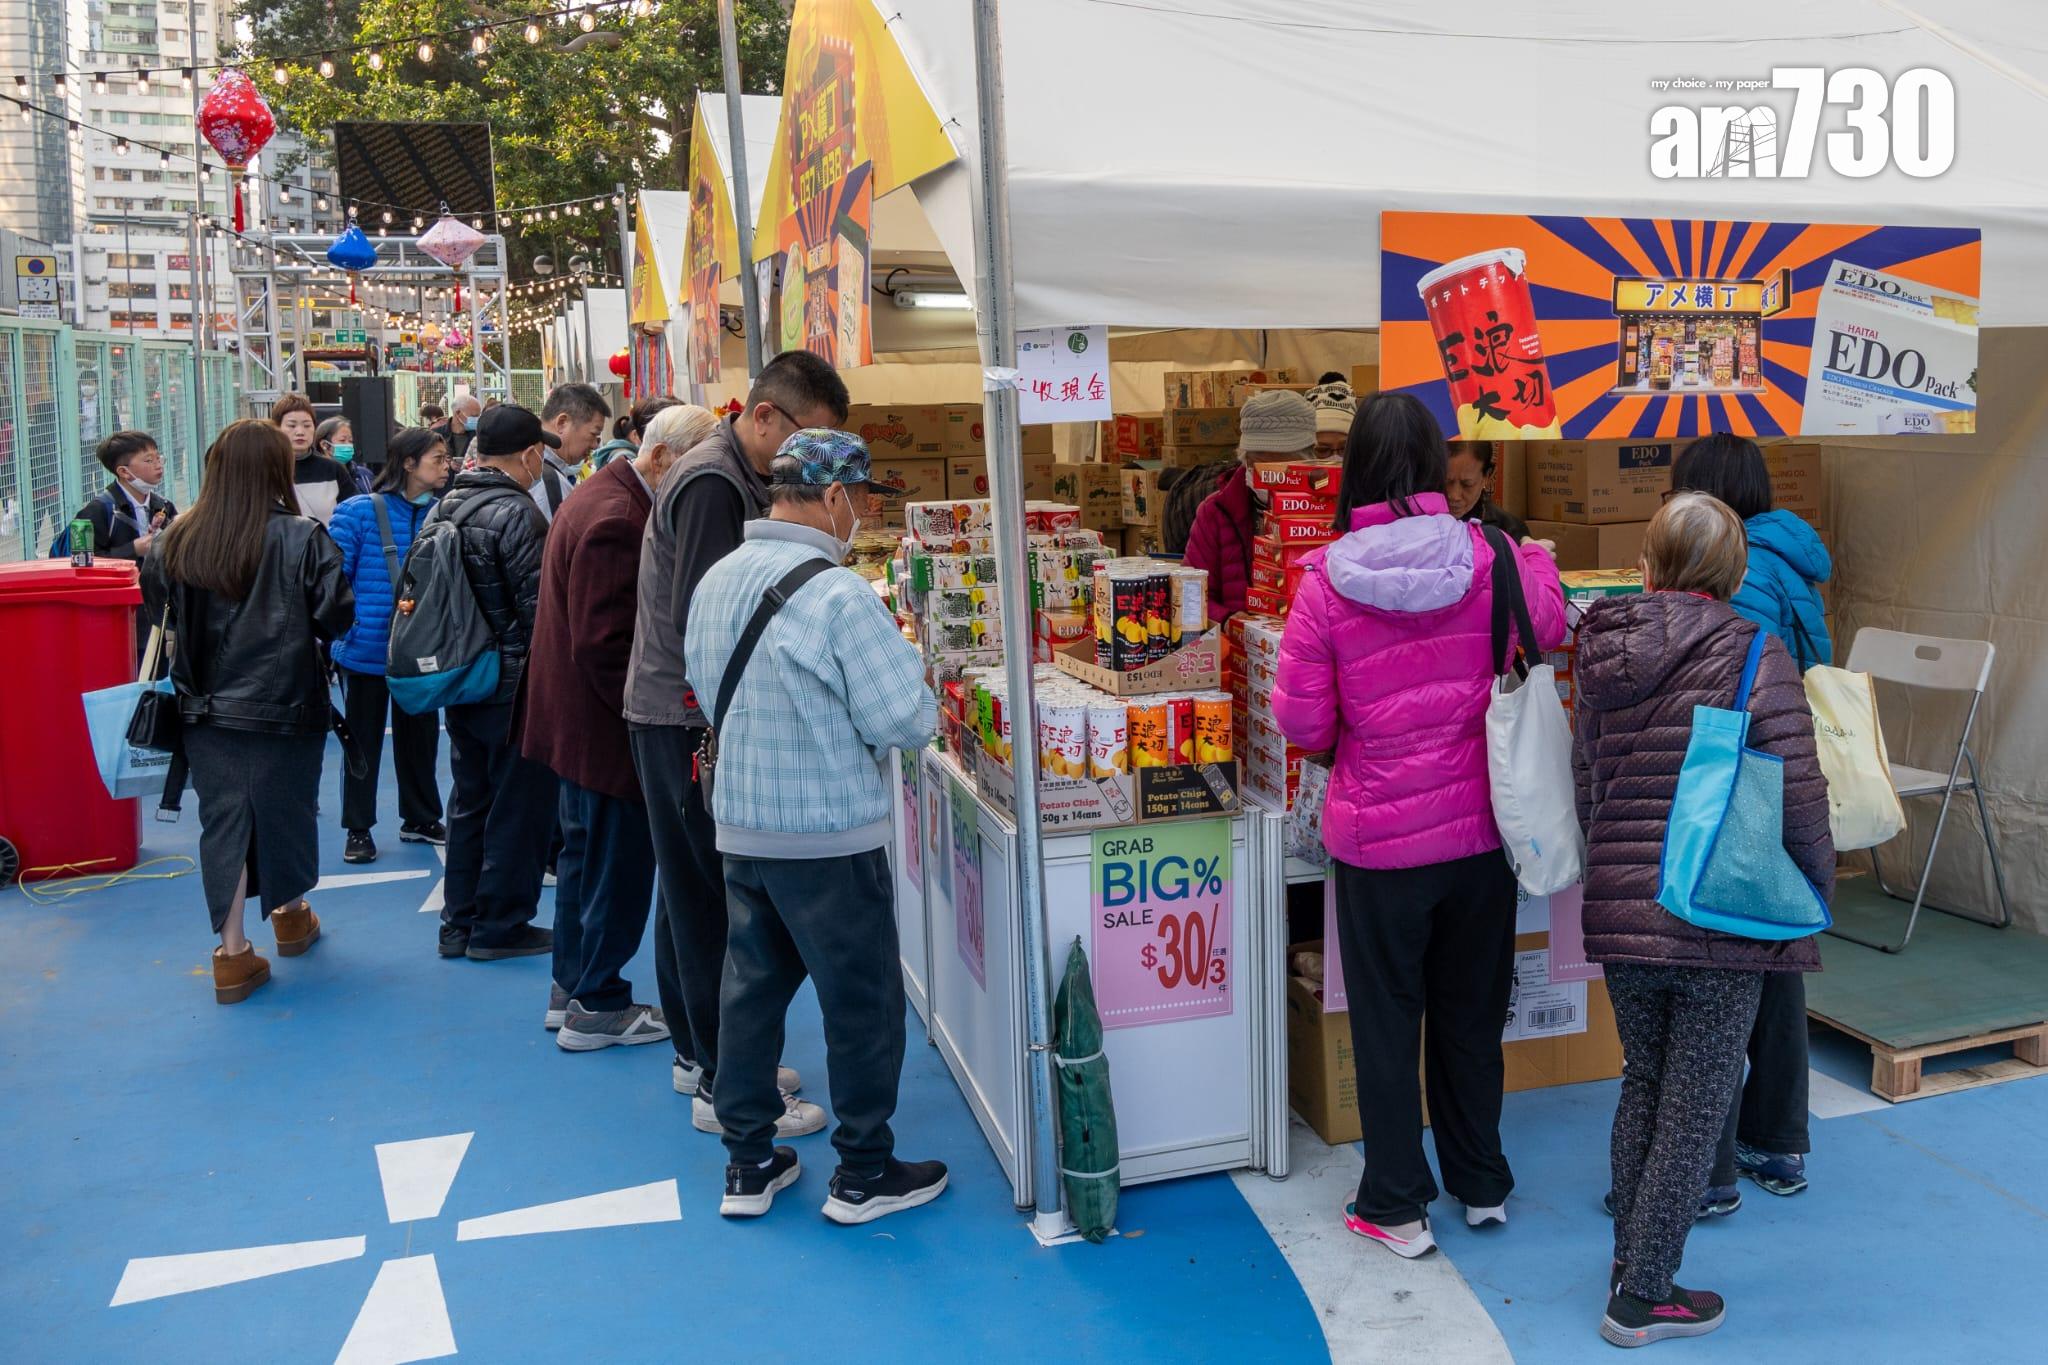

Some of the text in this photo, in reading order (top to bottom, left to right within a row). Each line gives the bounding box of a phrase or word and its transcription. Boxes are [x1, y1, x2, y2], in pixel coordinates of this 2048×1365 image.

[42, 278, 50, 287] 7
[1838, 268, 1901, 295] EDO
[43, 291, 50, 299] 7
[1646, 283, 1738, 308] アメ横丁
[1847, 324, 1879, 339] HAITAI
[1824, 329, 1926, 388] EDO
[1904, 417, 1931, 426] EDO
[1632, 446, 1660, 459] EDO
[1261, 470, 1302, 485] EDO Pack
[1282, 499, 1309, 511] EDO
[1289, 526, 1316, 537] EDO
[1248, 595, 1261, 608] EDO
[1058, 625, 1083, 636] EDO
[1148, 790, 1206, 802] Potato Chips
[1040, 798, 1100, 811] Potato Chips
[1147, 804, 1168, 815] 150g
[1181, 801, 1209, 810] 14cans
[1042, 813, 1060, 824] 50g
[1072, 810, 1102, 820] 14cans
[1103, 837, 1154, 857] GRAB
[1103, 909, 1154, 929] SALE
